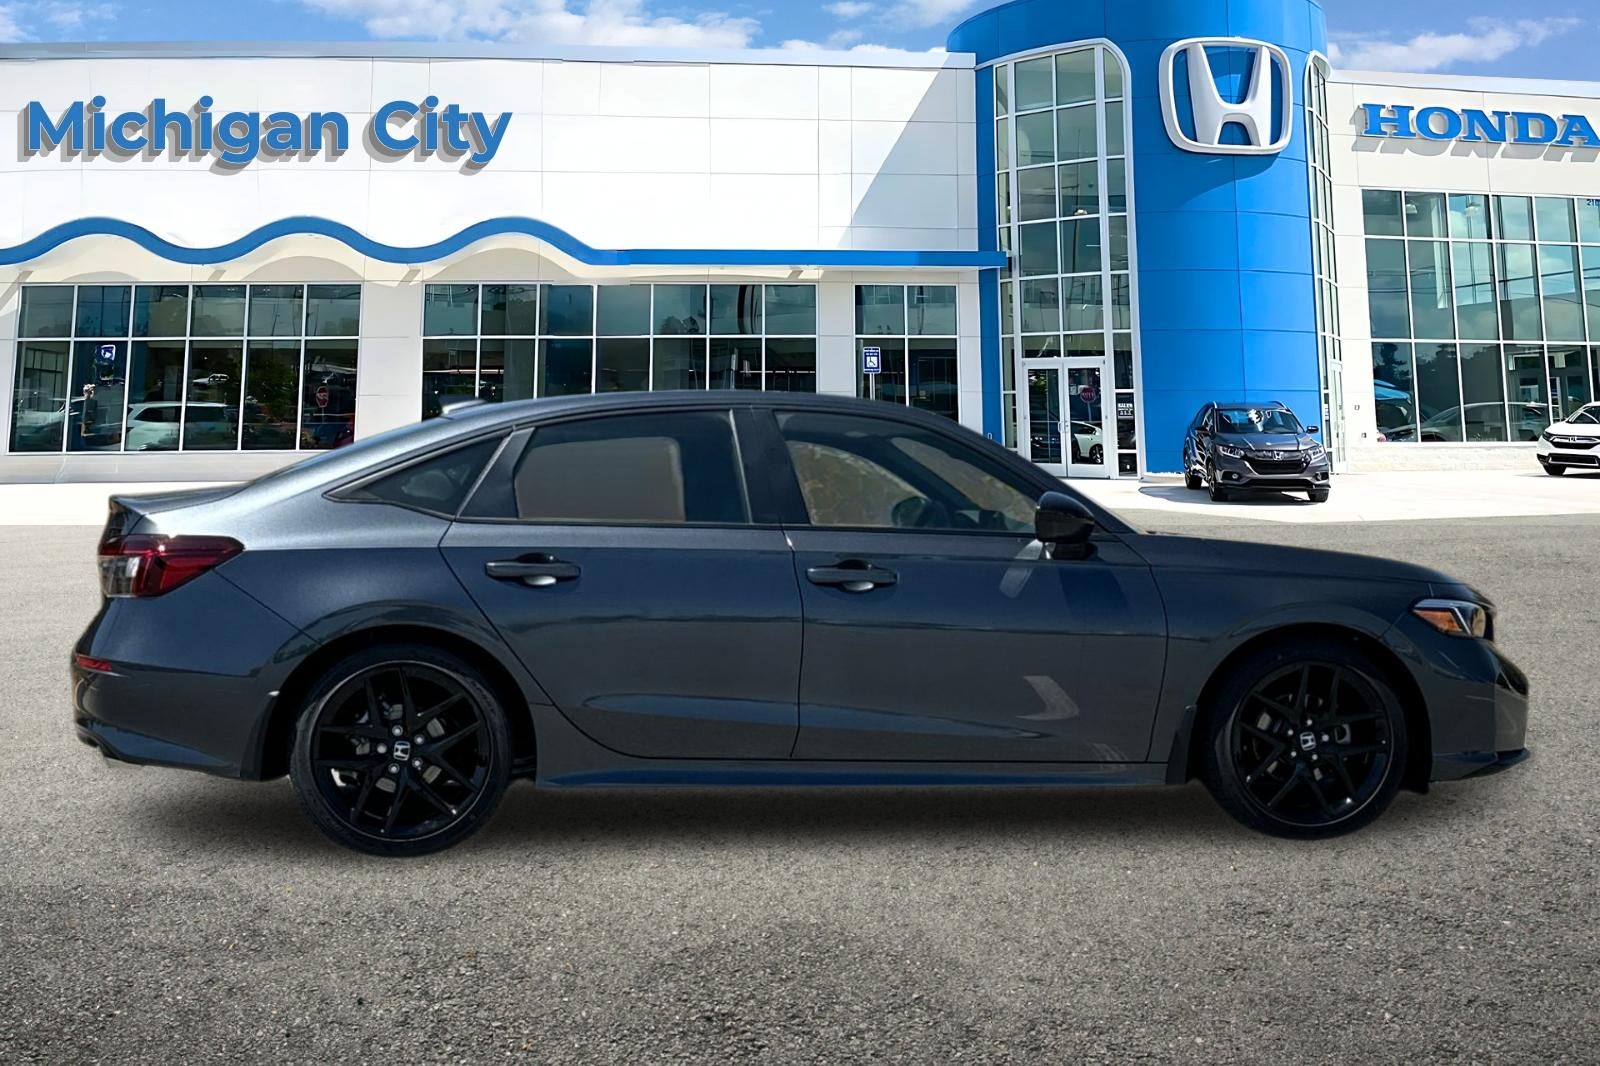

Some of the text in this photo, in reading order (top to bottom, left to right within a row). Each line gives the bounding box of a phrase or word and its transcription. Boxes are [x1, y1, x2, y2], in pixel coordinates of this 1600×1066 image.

[28, 95, 513, 164] Michigan City
[1362, 103, 1600, 147] HONDA
